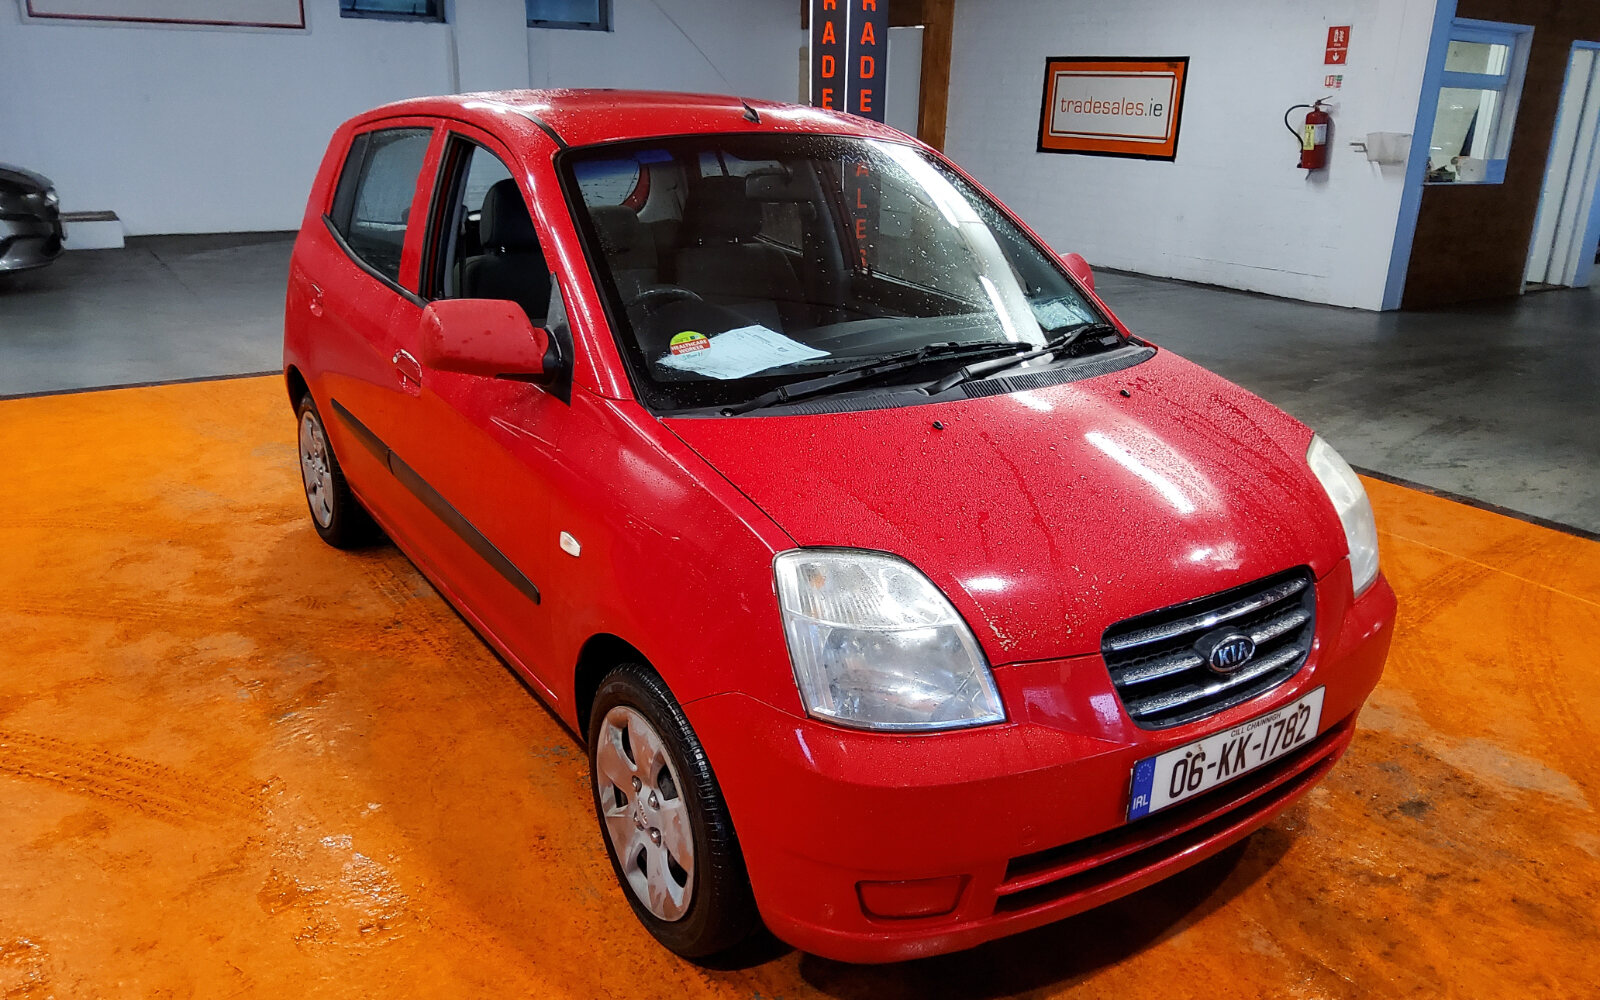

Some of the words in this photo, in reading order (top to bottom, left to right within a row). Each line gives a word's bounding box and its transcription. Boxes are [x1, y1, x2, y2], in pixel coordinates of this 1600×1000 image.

[1060, 95, 1163, 117] tradesales.ie
[1217, 641, 1250, 667] KIA
[1168, 705, 1311, 799] 06-KK-1782
[1132, 793, 1149, 811] IRL
